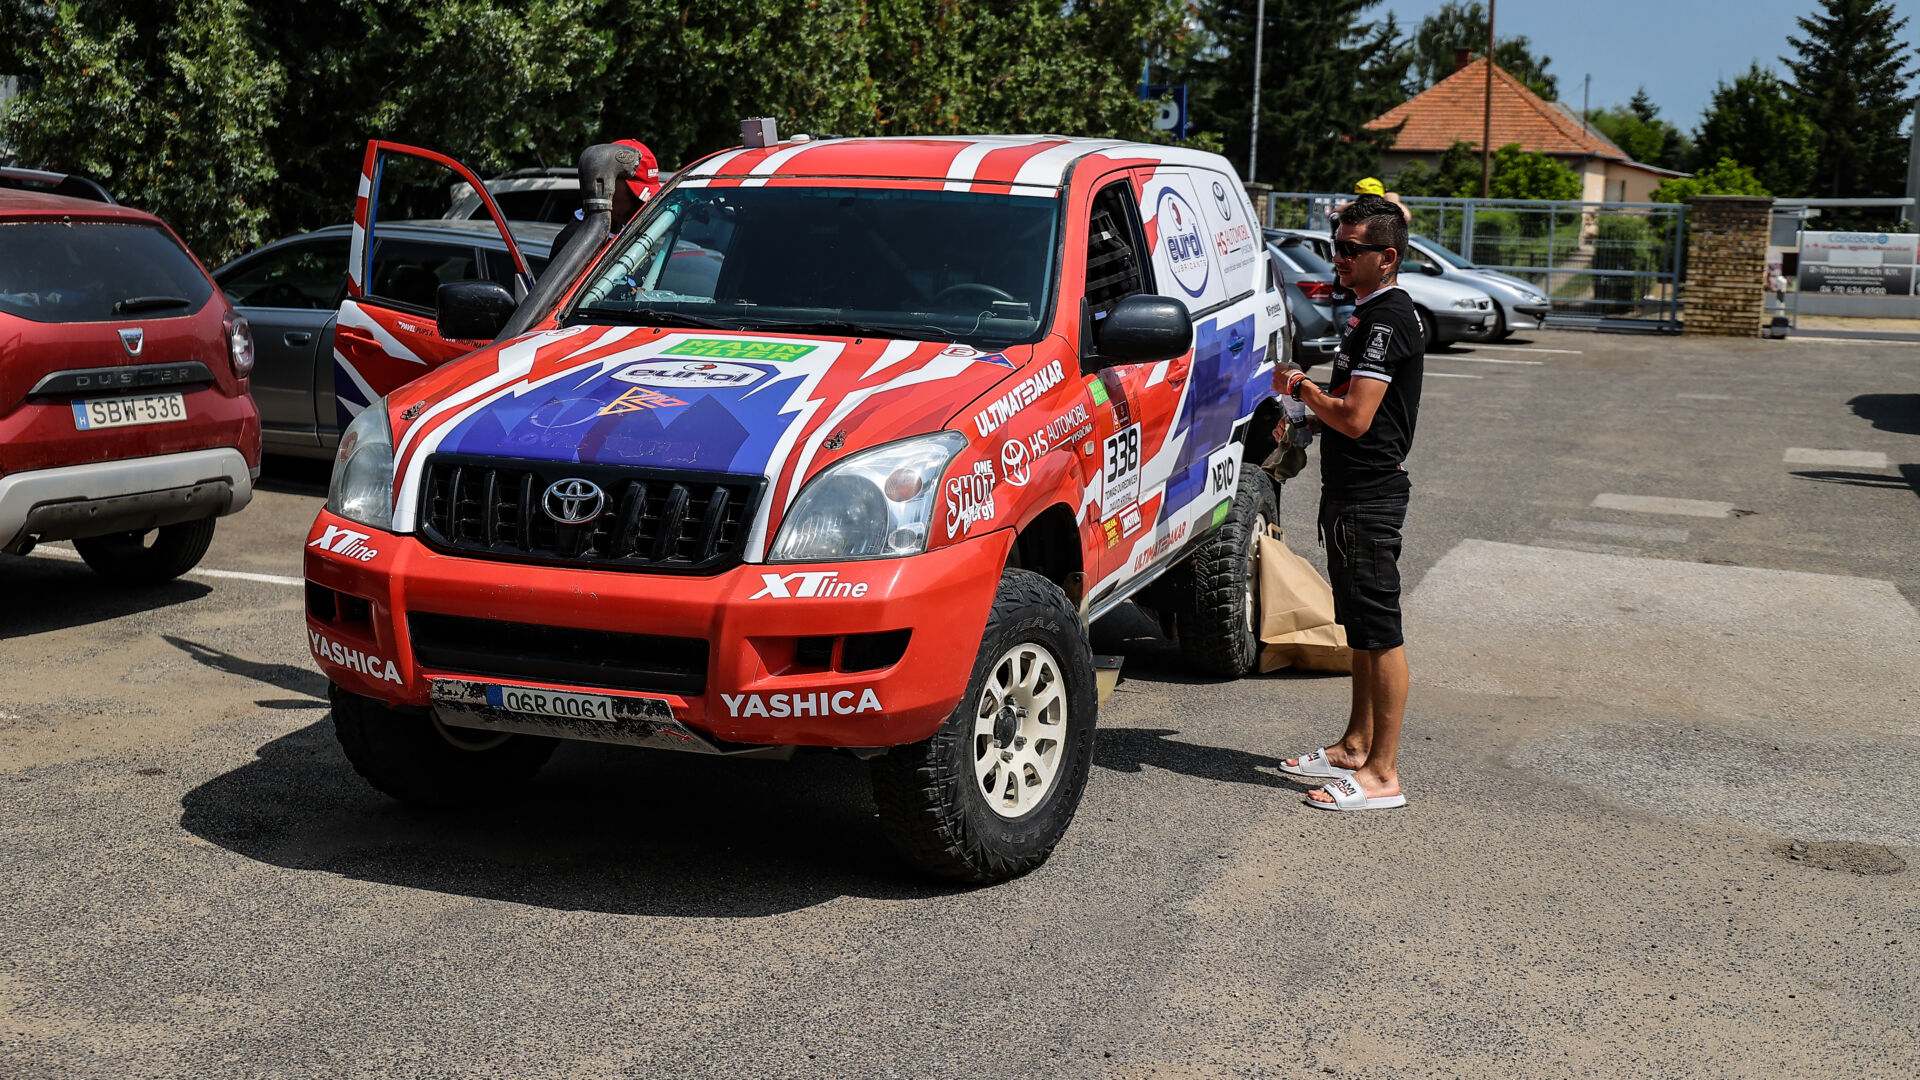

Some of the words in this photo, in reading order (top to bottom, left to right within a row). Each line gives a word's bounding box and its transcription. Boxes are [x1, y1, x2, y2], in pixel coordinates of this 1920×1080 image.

[1167, 223, 1204, 263] eurol
[1214, 232, 1228, 256] HS
[671, 347, 794, 361] FILTER
[687, 340, 809, 354] MANN
[76, 368, 190, 387] DUSTER
[626, 368, 753, 382] eurol
[80, 416, 87, 425] H
[92, 395, 181, 425] SBW-536
[1028, 429, 1049, 461] HS
[1046, 403, 1090, 443] AUTOMOBIL
[973, 459, 993, 474] ONE
[1107, 427, 1138, 483] 338
[945, 471, 995, 539] SHOT
[308, 629, 403, 685] YASHICA
[552, 696, 612, 720] 0061
[720, 688, 883, 718] YASHICA
